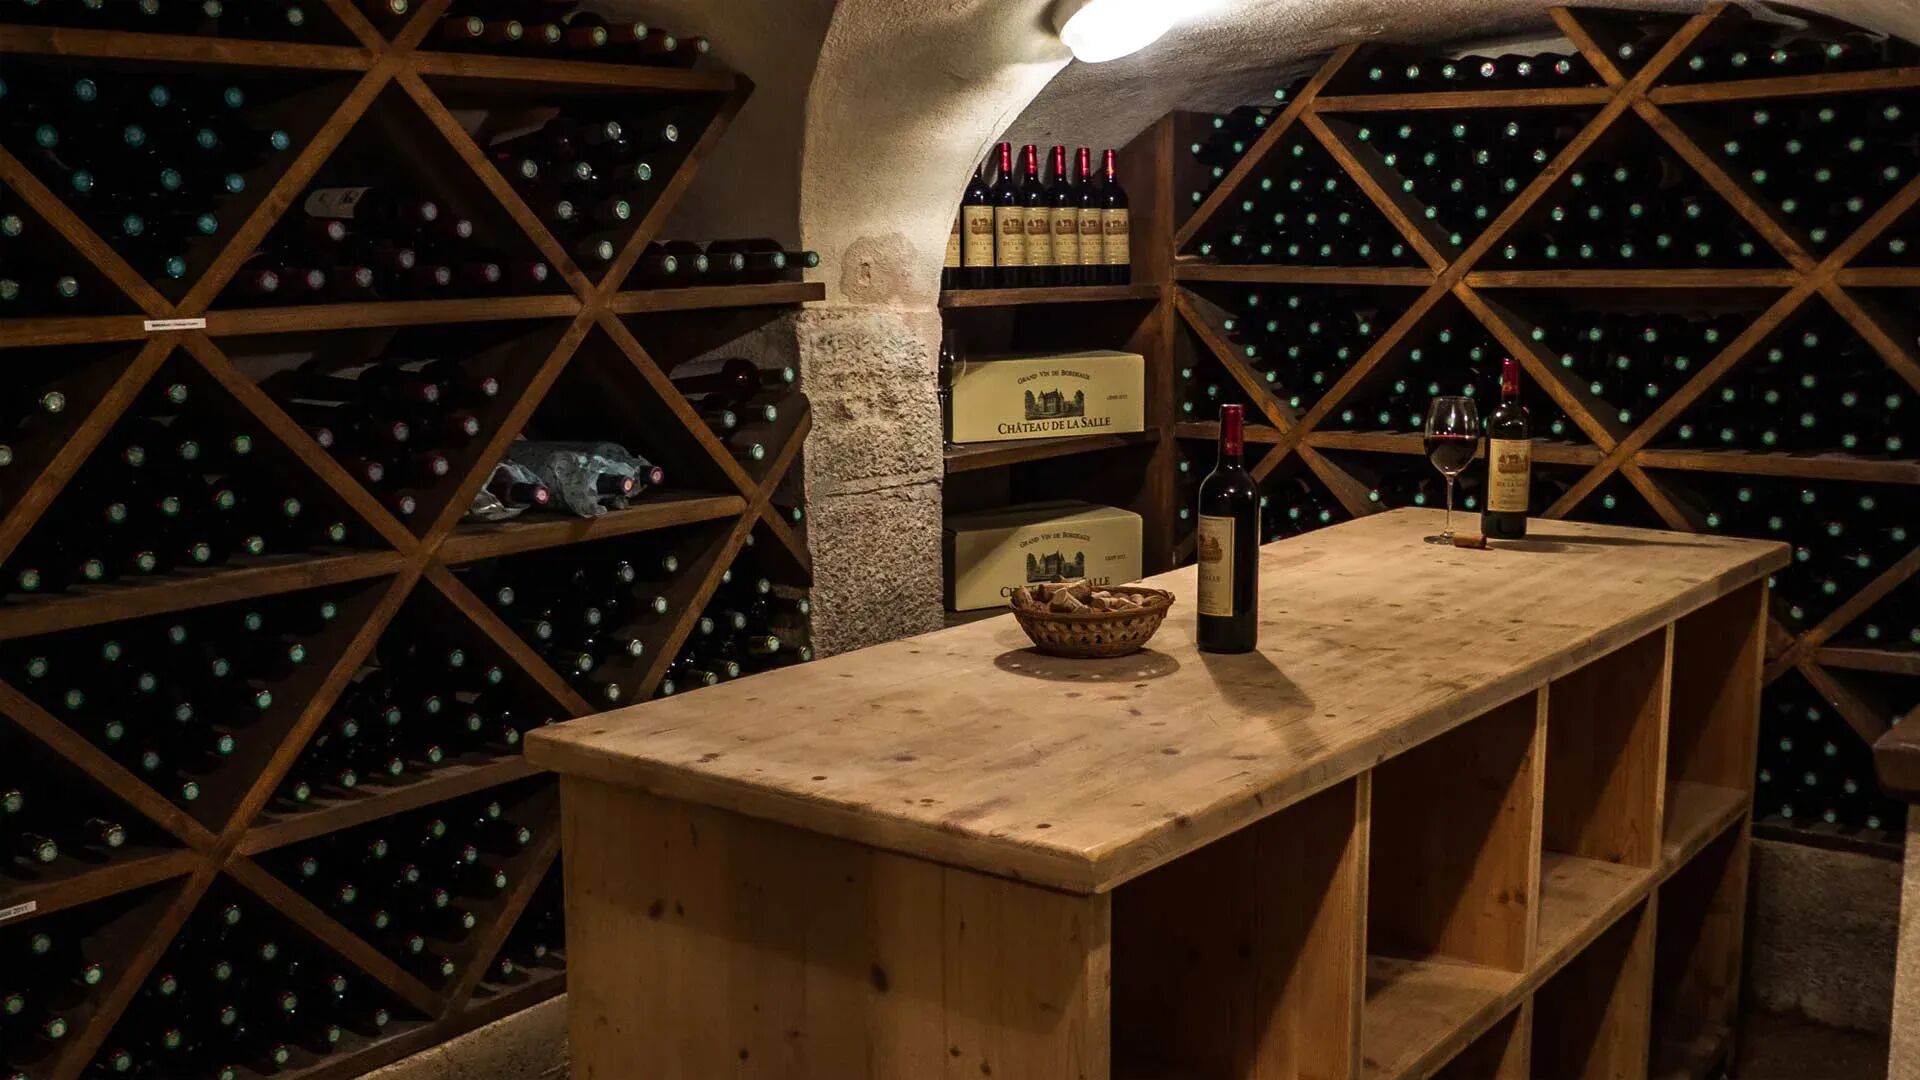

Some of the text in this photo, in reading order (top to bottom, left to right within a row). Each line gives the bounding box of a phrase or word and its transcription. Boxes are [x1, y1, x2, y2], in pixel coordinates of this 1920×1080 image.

[1017, 373, 1038, 385] GRAND
[1061, 369, 1091, 380] BORDEAUX
[997, 416, 1112, 435] CHÂTEAU DE LA SALLE
[1019, 536, 1039, 549] GRAND
[1062, 531, 1091, 542] BORDEAUX
[1084, 576, 1111, 587] ALLE
